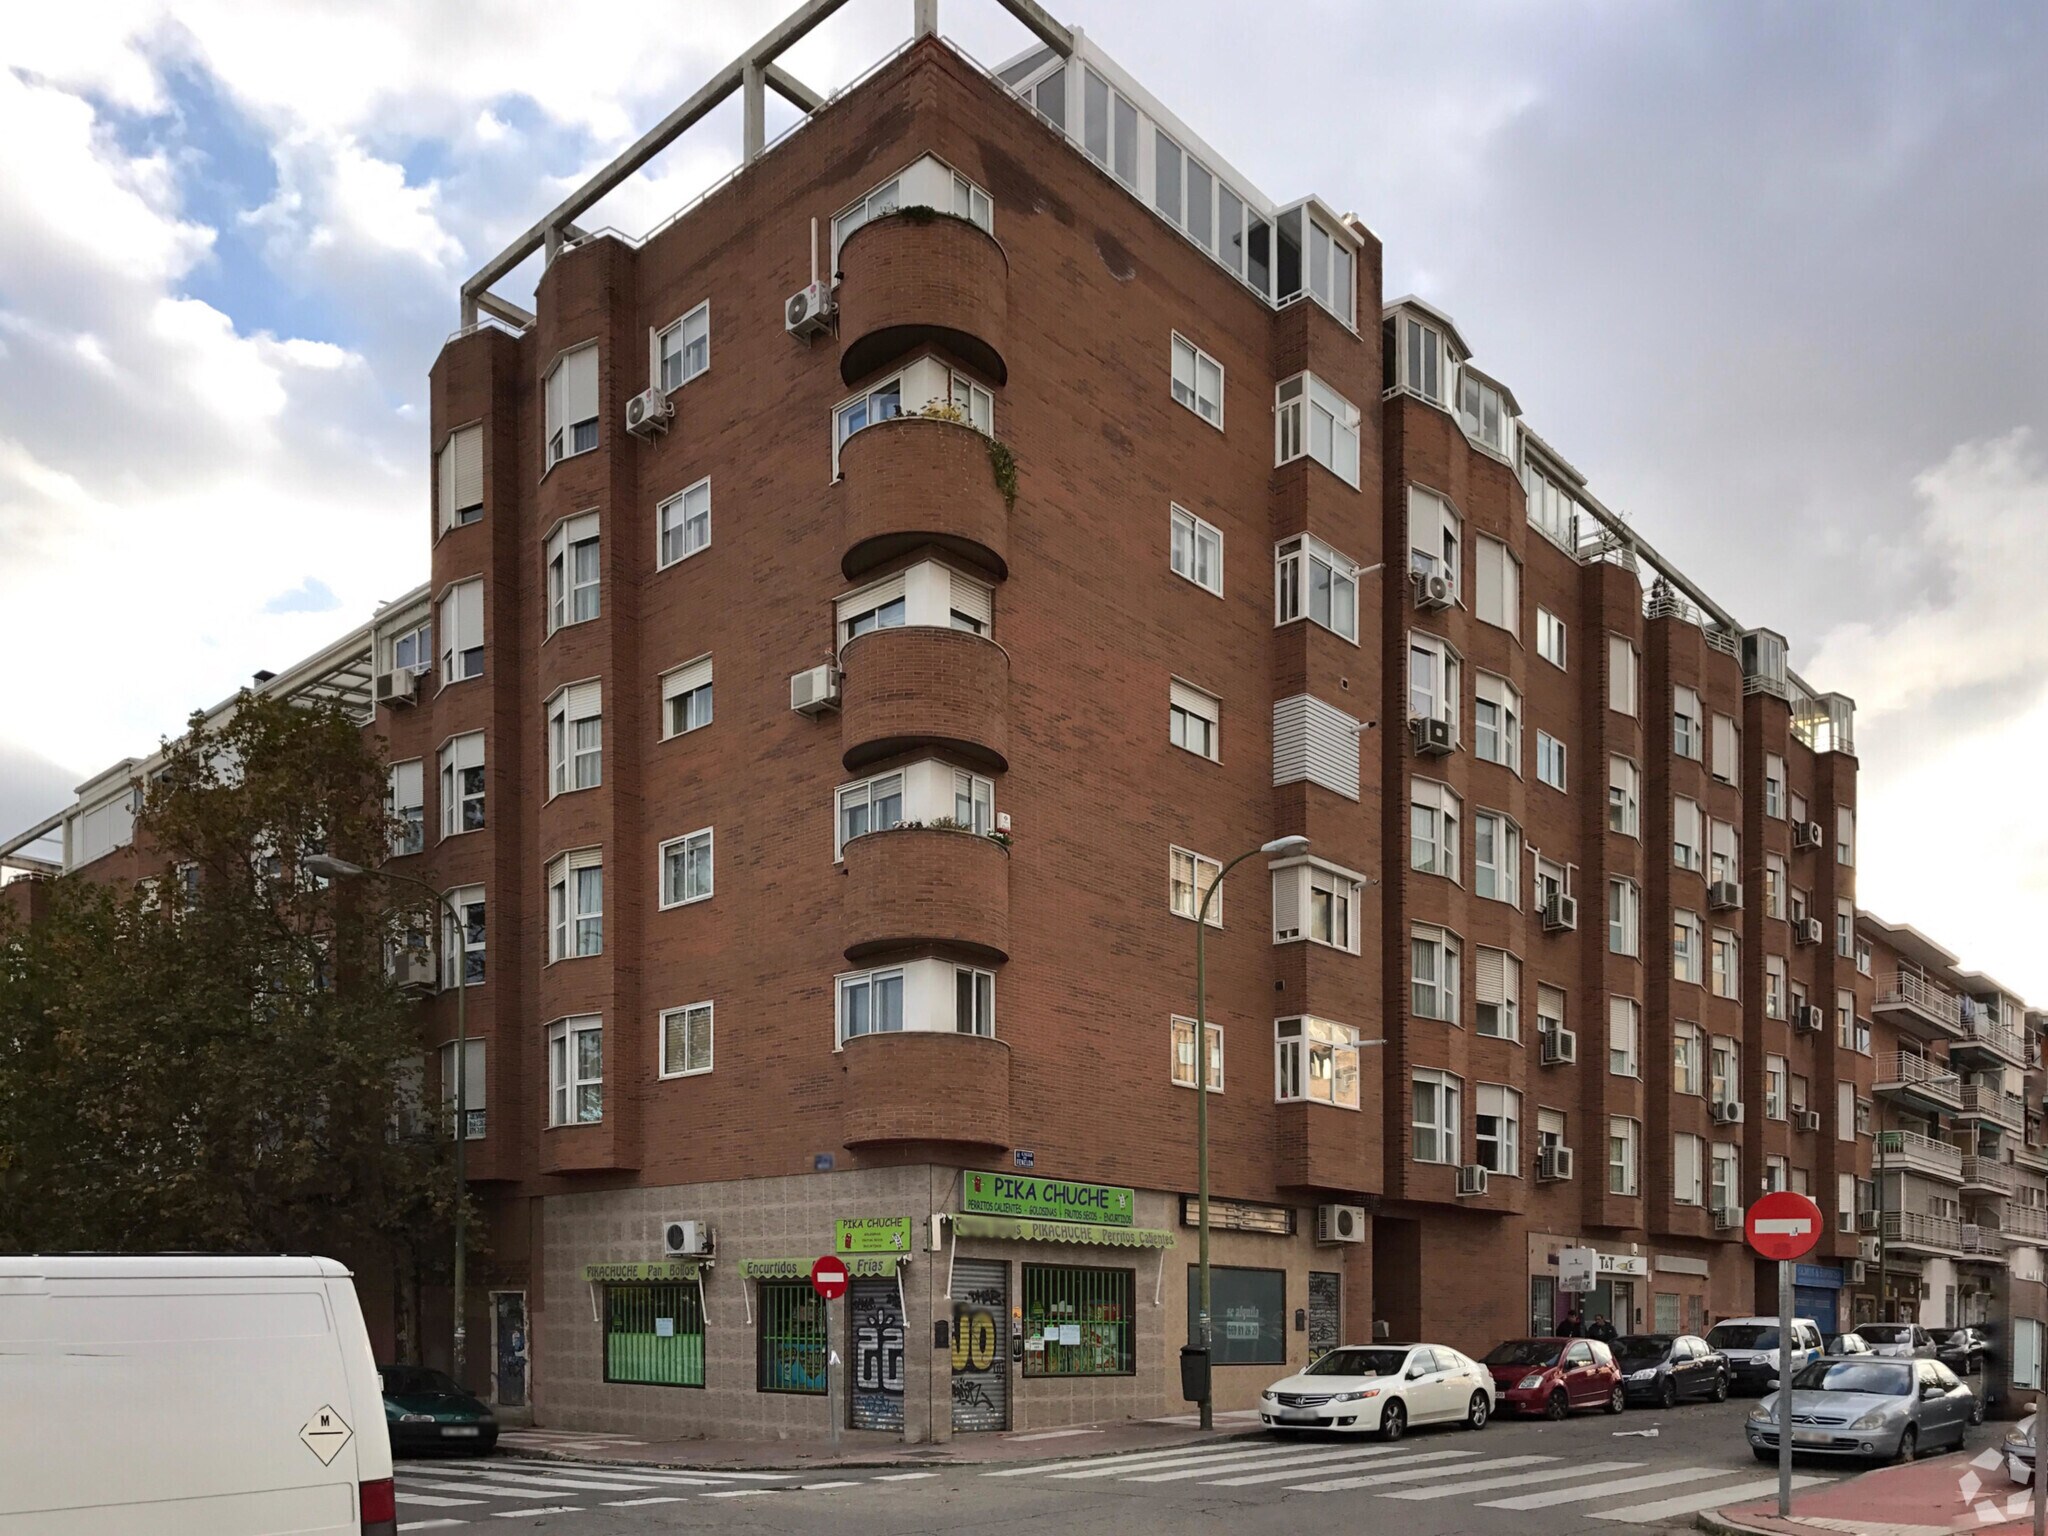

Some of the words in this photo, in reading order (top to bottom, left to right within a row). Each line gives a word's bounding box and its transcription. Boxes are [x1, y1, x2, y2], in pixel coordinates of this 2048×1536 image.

[994, 1178, 1037, 1201] PIKA
[1043, 1183, 1110, 1209] CHUCHE
[968, 1199, 994, 1211] PERRITOS
[994, 1202, 1022, 1214] CALIENTES
[1029, 1205, 1057, 1217] GOLOSINAS
[1065, 1208, 1082, 1220] FRUTOS
[1083, 1210, 1098, 1221] SECOS
[1104, 1212, 1132, 1224] ENCURTIDOS
[843, 1219, 864, 1229] PIKA
[867, 1217, 903, 1228] CHUCHE
[1032, 1223, 1093, 1240] PIKACHUCHE
[1102, 1229, 1135, 1243] Perritos
[1139, 1231, 1174, 1245] Calientes
[586, 1265, 638, 1277] PIKACHUCHE
[647, 1264, 662, 1276] Pan
[669, 1264, 695, 1276] Bollos
[747, 1261, 797, 1274] Encurtidos
[857, 1258, 884, 1272] Frías
[1599, 1256, 1614, 1270] T&T
[321, 1415, 330, 1426] M
